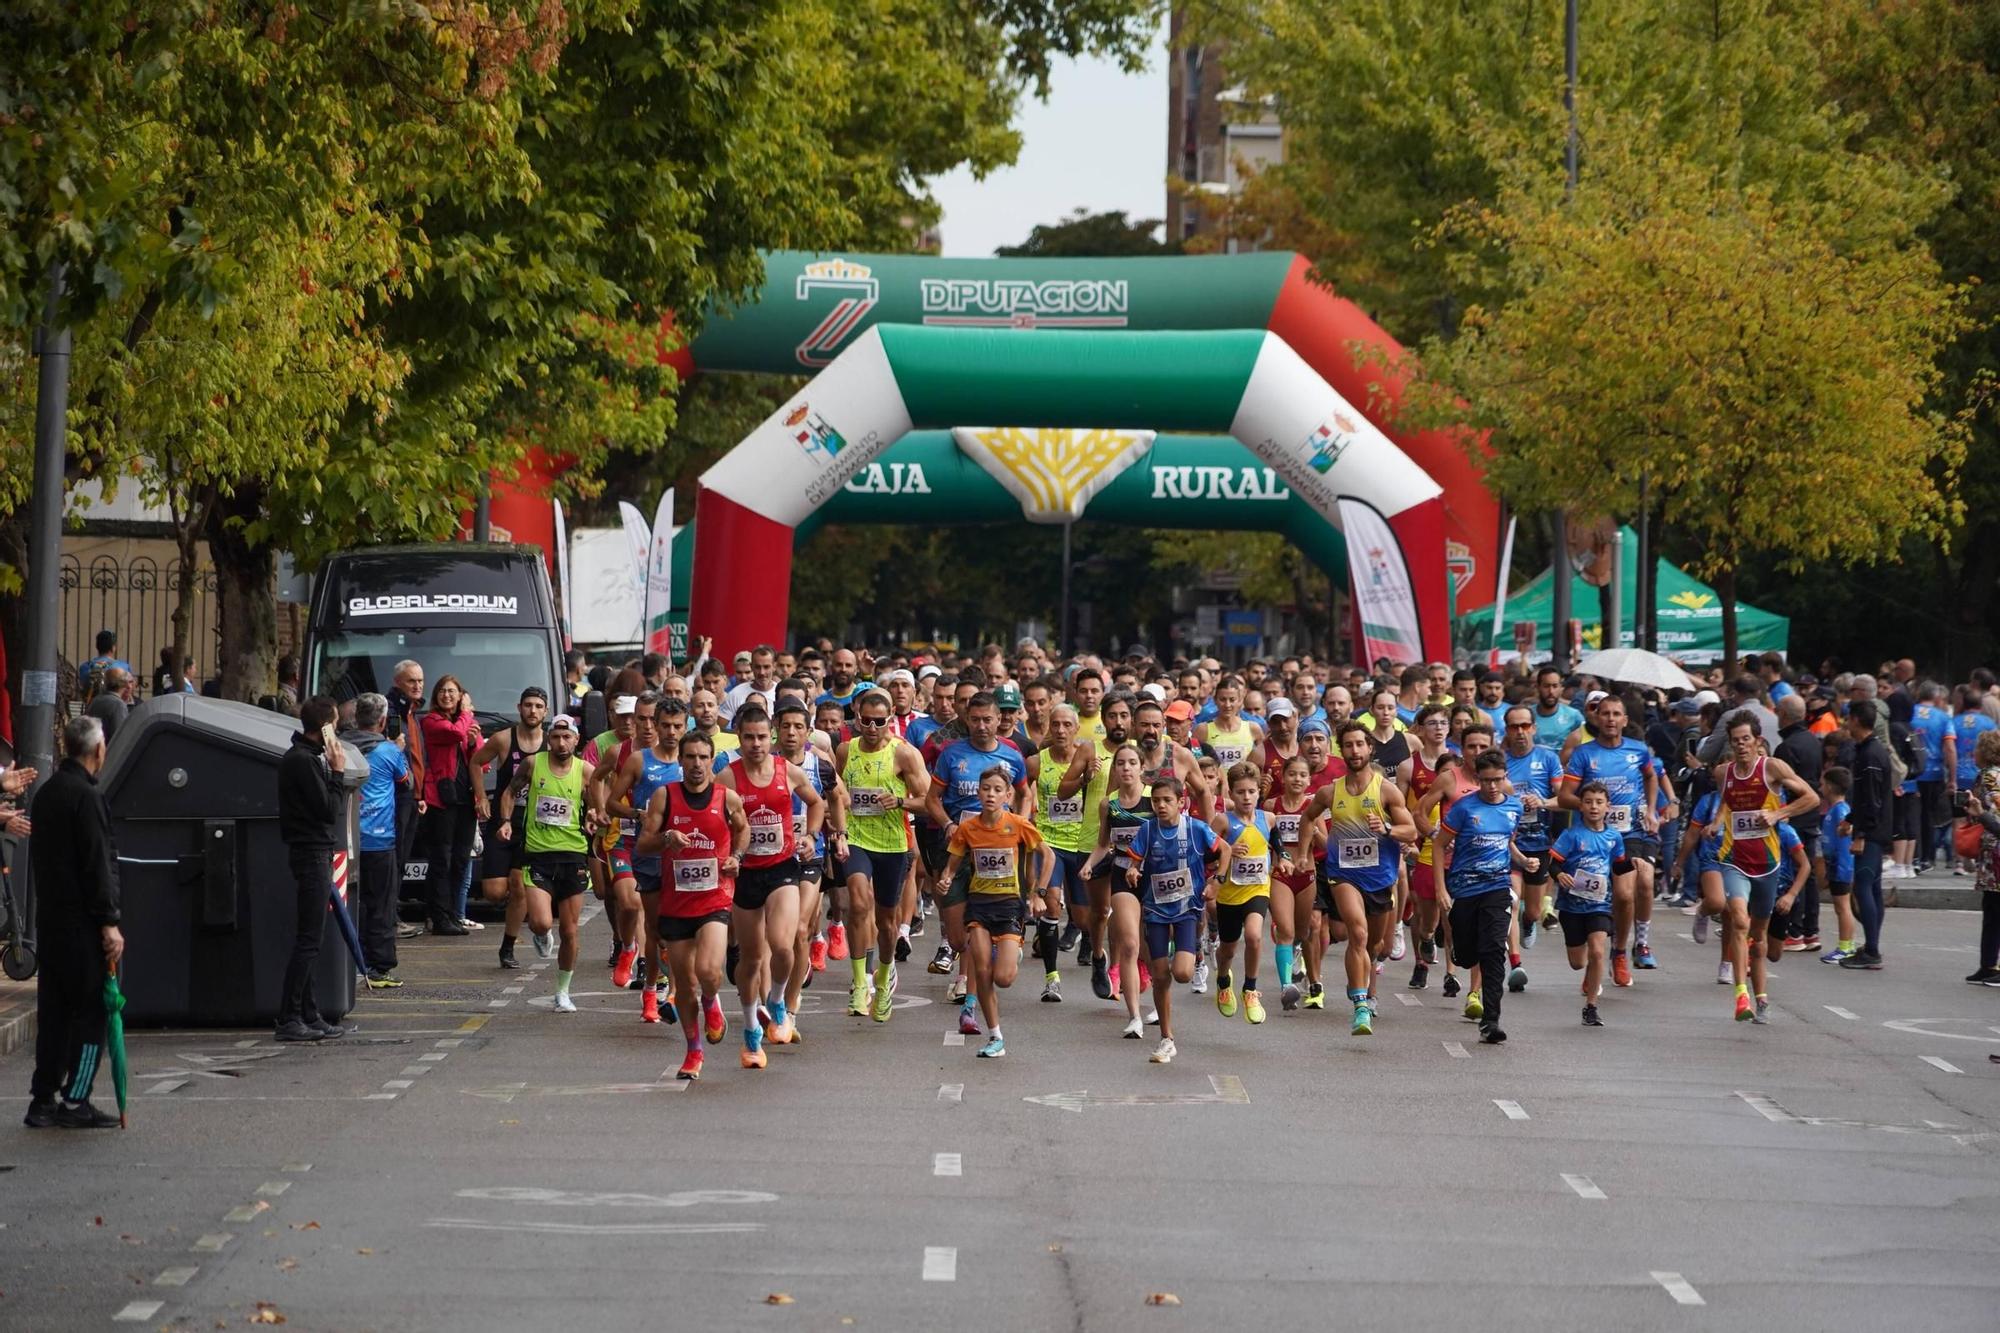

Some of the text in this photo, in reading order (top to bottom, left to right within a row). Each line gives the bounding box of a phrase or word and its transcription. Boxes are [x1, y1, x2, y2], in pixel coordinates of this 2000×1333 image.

[804, 430, 878, 498] AYUNTAMIENTO
[1264, 437, 1339, 504] AYUNTAMIENTO
[809, 438, 886, 506] DE ZAMORA
[1256, 443, 1331, 512] DE ZAMORA
[843, 462, 1291, 500] CAJA RURAL
[349, 594, 518, 611] GLOBALPODIUM
[1220, 750, 1242, 760] 183
[853, 792, 878, 805] 596
[542, 802, 567, 815] 345
[1053, 802, 1078, 813] 673
[1346, 845, 1372, 857] 510
[980, 855, 1007, 867] 364
[681, 866, 711, 879] 638
[1238, 863, 1264, 874] 522
[1158, 876, 1186, 892] 560
[1584, 879, 1600, 890] 13
